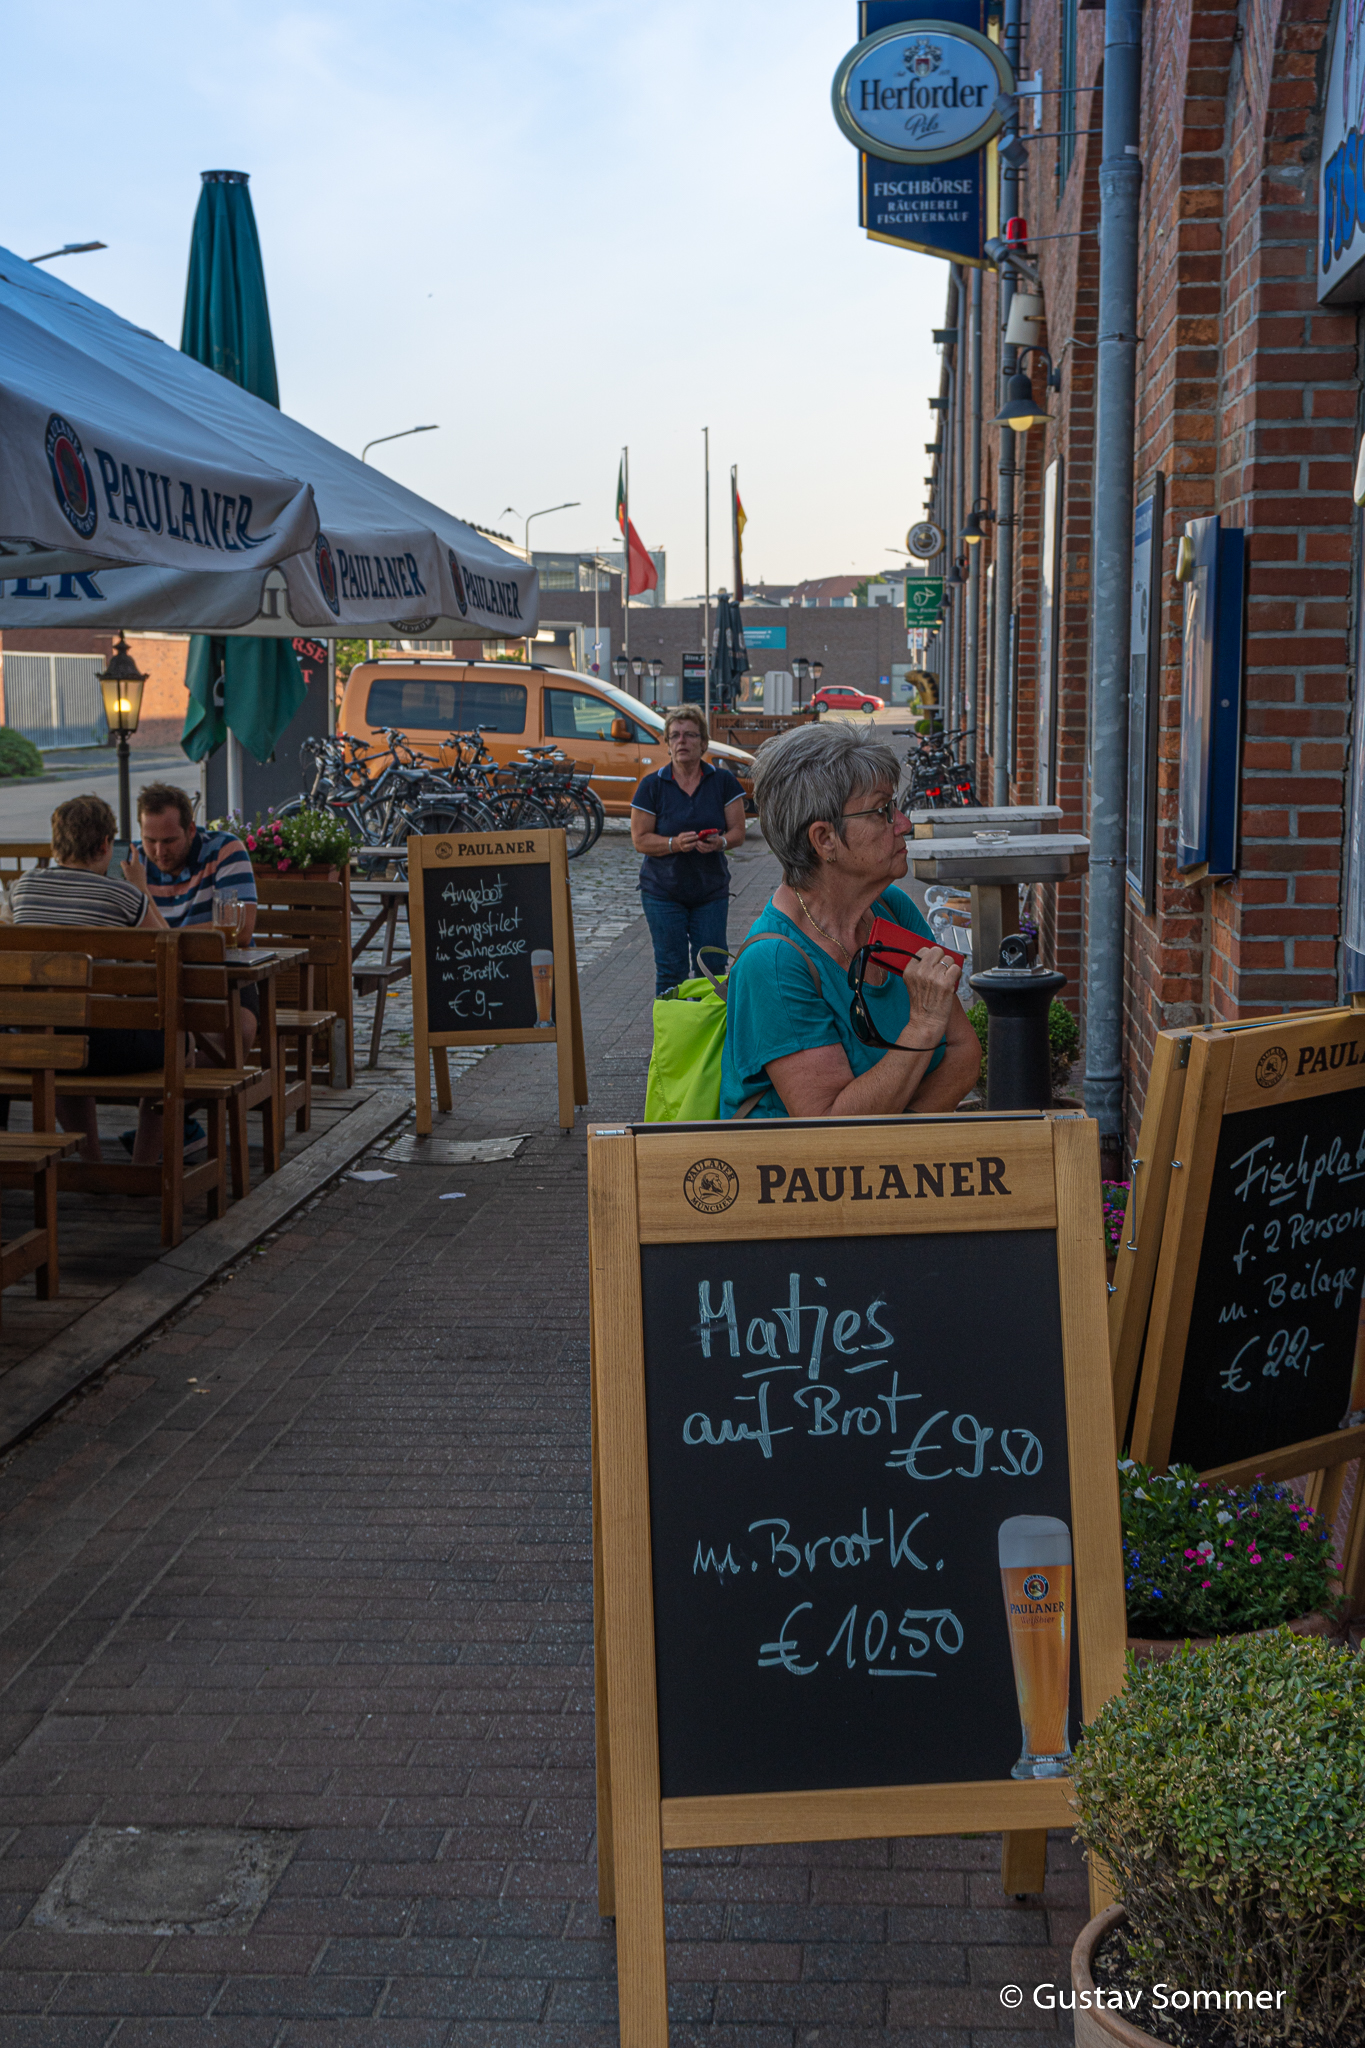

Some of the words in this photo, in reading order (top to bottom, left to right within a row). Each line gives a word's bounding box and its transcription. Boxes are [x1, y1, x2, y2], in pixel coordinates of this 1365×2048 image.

[859, 76, 988, 110] Herforder
[904, 113, 946, 140] Pils
[873, 176, 973, 197] FISCHBÖRSE
[876, 212, 969, 225] FISCHVERKAUF
[887, 199, 959, 212] RÄUCHEREI
[94, 447, 276, 551] PAULANER
[336, 548, 427, 599] PAULANER
[461, 565, 523, 620] PAULANER
[457, 840, 536, 857] PAULANER
[441, 873, 508, 913] Angebot
[437, 906, 523, 941] Heringsfilet
[435, 945, 450, 962] in
[454, 938, 528, 959] Sahnesosse
[442, 969, 459, 982] m.
[1295, 1040, 1365, 1077] PAUL
[686, 1160, 736, 1182] PAULANER
[756, 1156, 1012, 1204] PAULANER
[1232, 1223, 1257, 1275] f.
[1265, 1218, 1283, 1254] 2
[1218, 1302, 1260, 1325] m.
[1263, 1262, 1358, 1310] Beilage
[697, 1271, 895, 1380] Matjes
[682, 1382, 793, 1459] auf
[794, 1371, 923, 1437] Brot
[693, 1537, 759, 1575] m.
[1010, 1601, 1065, 1615] PAULANER
[1020, 1615, 1056, 1626] Weißbier
